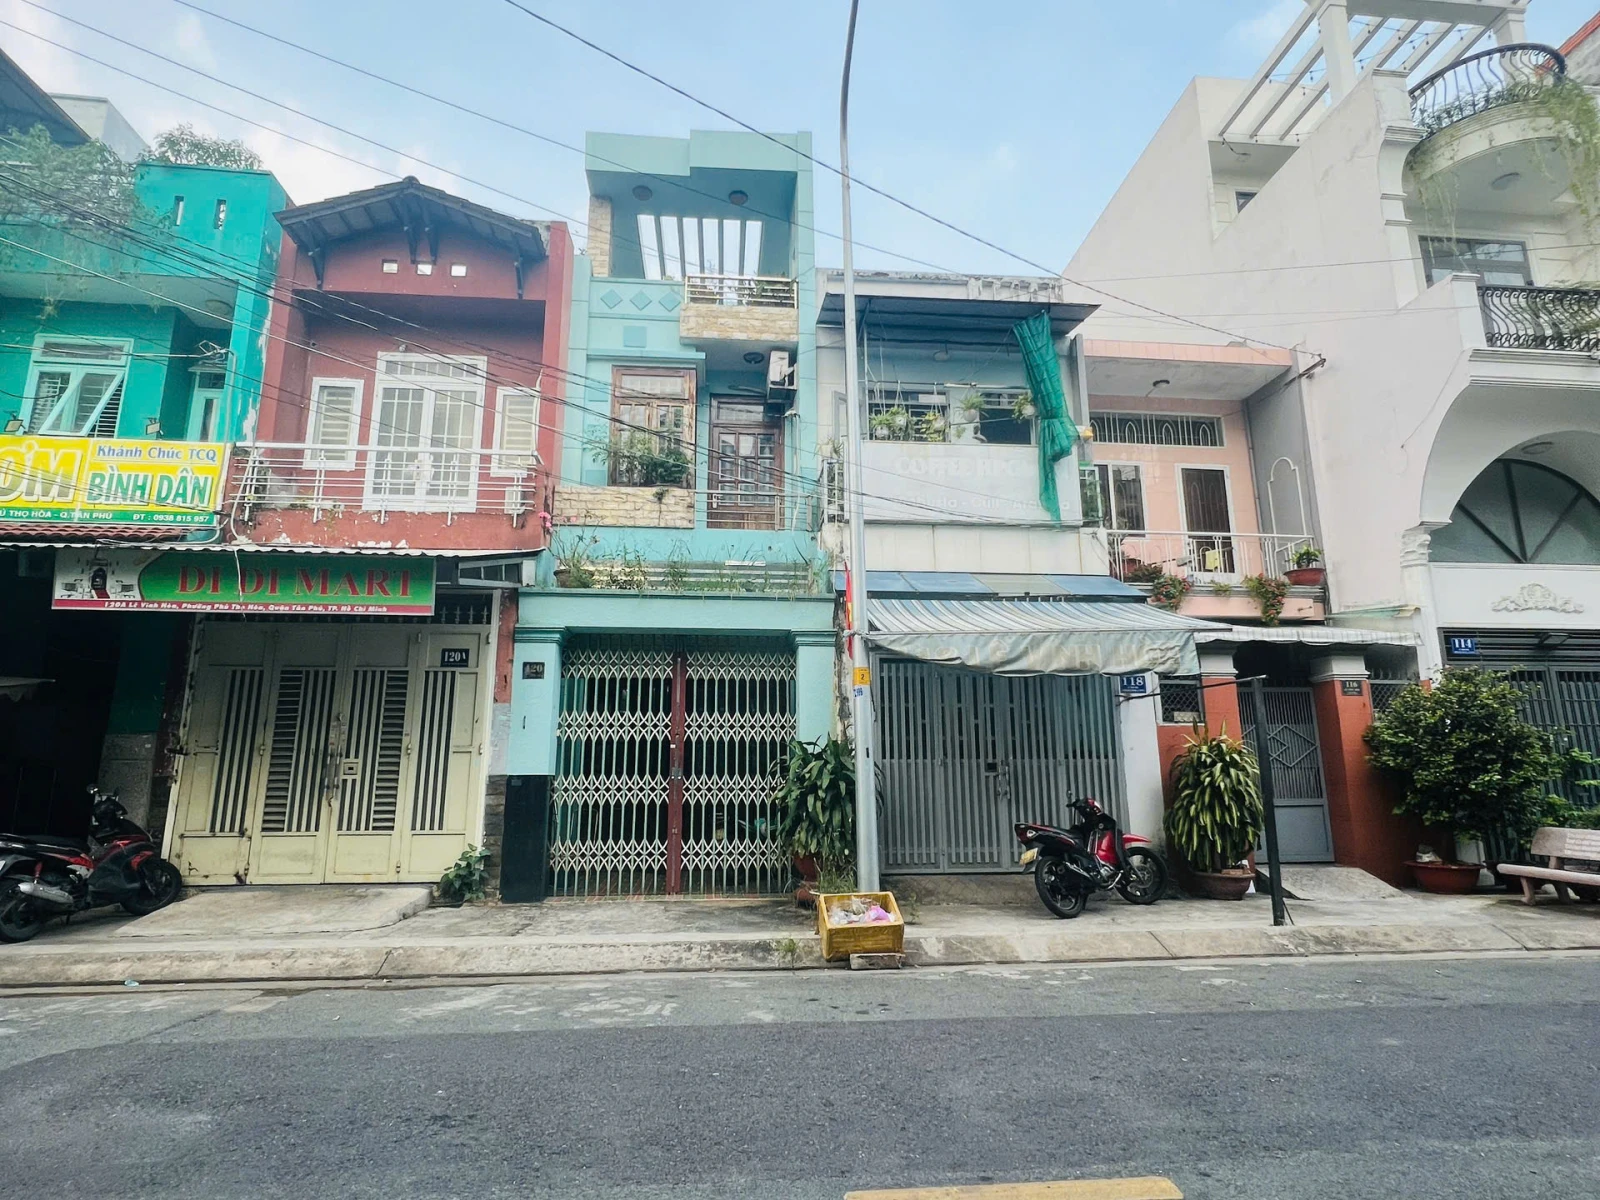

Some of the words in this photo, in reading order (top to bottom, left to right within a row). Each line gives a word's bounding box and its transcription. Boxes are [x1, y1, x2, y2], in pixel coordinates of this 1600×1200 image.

[97, 444, 142, 458] Khánh
[148, 446, 182, 460] Chúc
[188, 448, 217, 463] TCQ
[86, 465, 149, 503] BÌNH
[155, 467, 209, 506] DÂN
[9, 509, 29, 518] THỌ
[31, 509, 52, 518] HÒA
[92, 511, 113, 520] PHÚ
[176, 566, 221, 594] DI
[235, 567, 280, 595] DI
[1455, 639, 1472, 648] 114
[1122, 677, 1143, 686] 118
